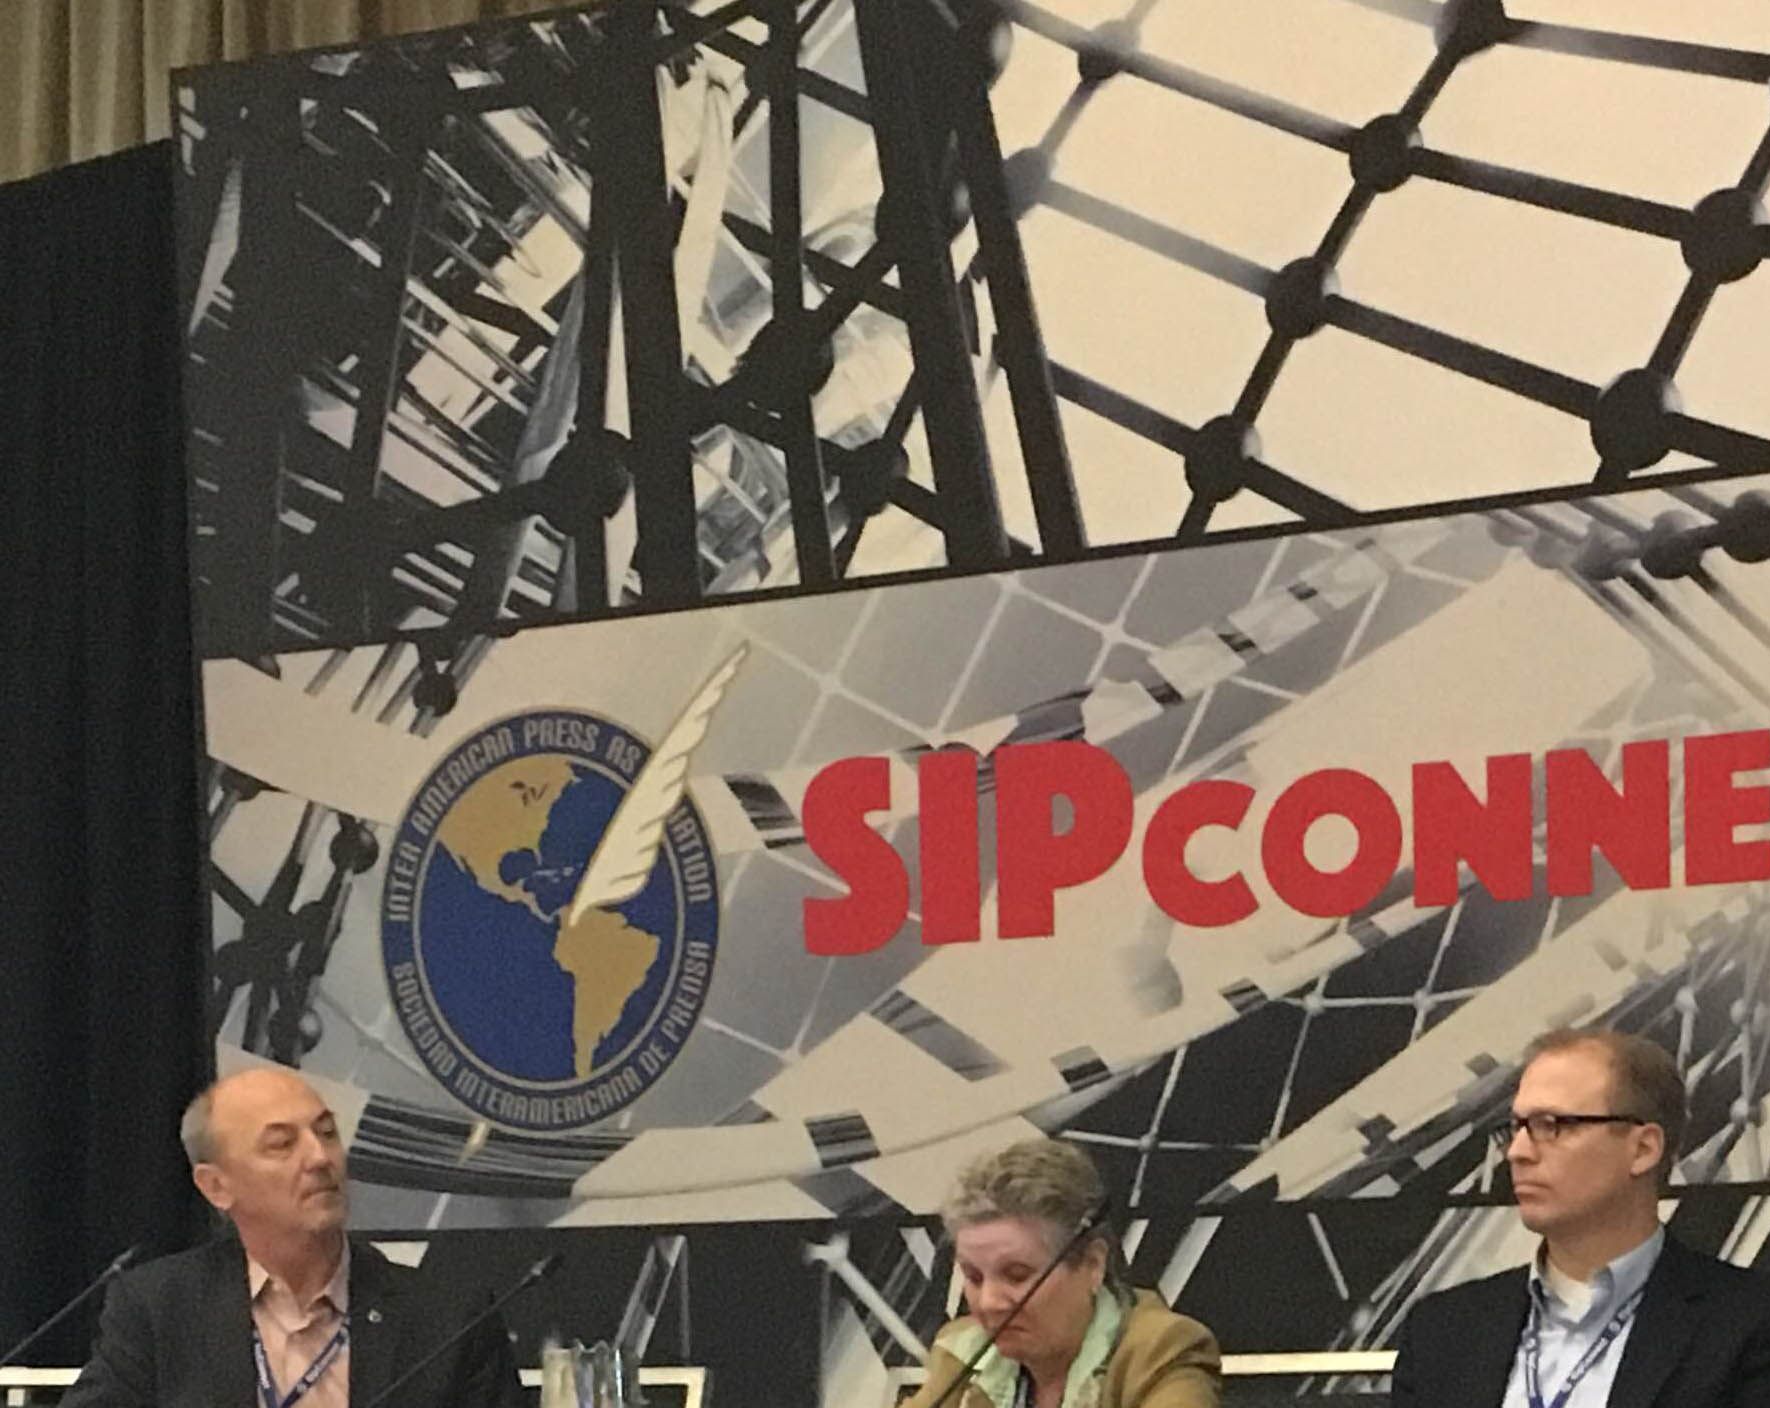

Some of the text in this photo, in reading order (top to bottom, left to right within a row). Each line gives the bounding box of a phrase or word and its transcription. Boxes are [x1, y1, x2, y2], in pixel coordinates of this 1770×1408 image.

[389, 842, 421, 922] INTER
[411, 727, 515, 836] AMERICAN
[523, 718, 600, 752] PRESS
[392, 940, 710, 1125] SOCIEDAD INTERAMERICANA DE PRENSA
